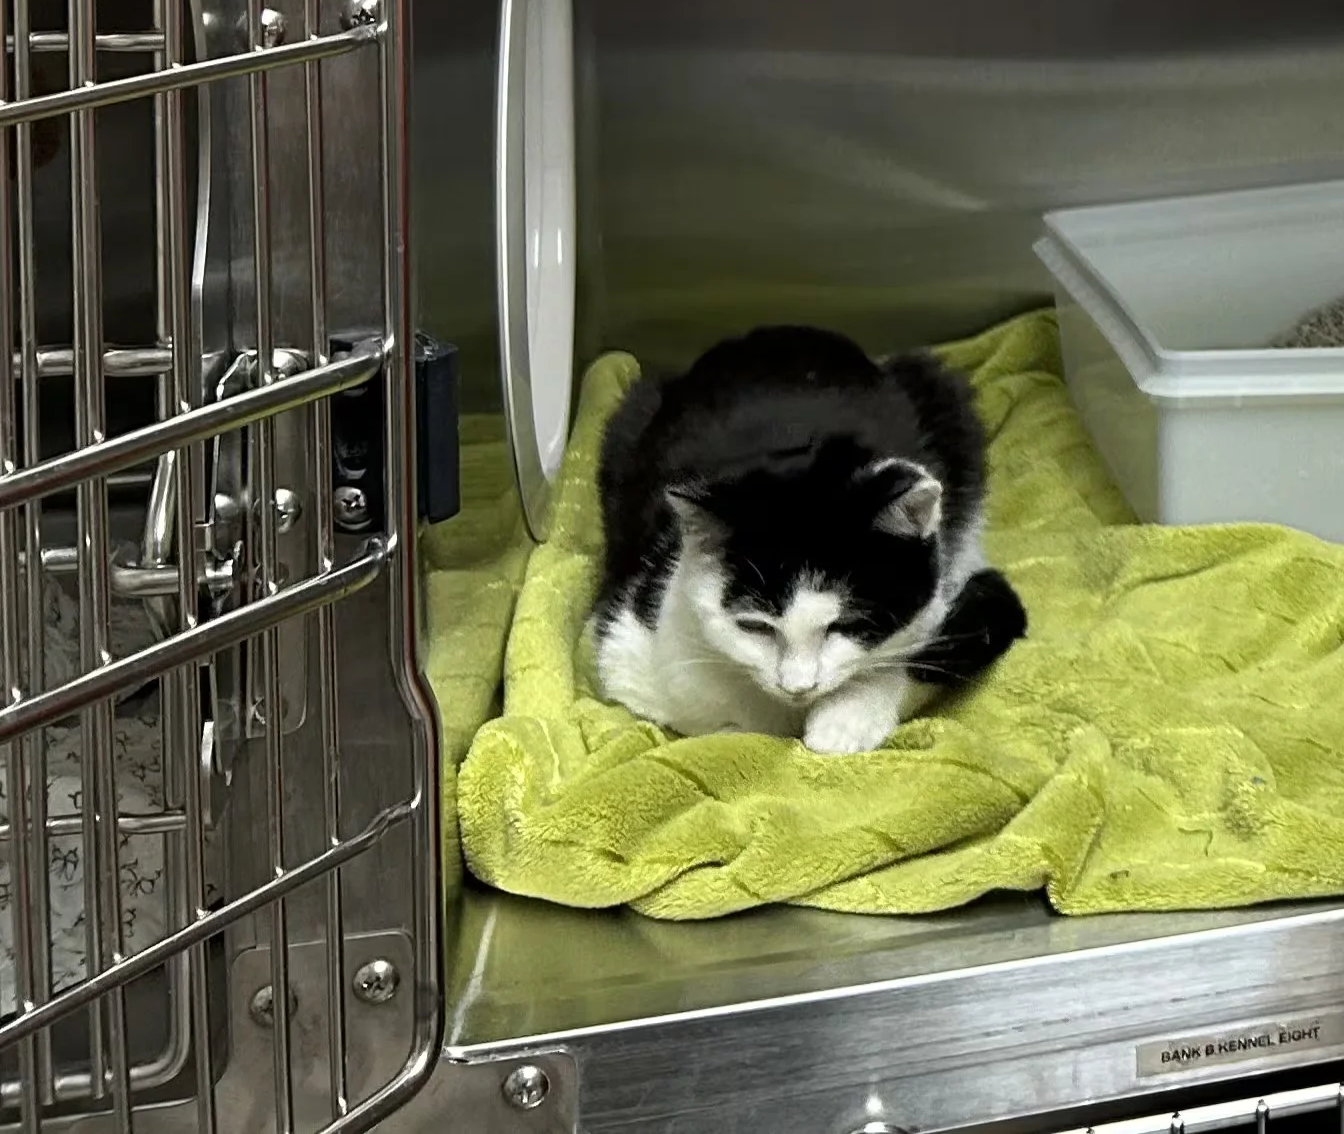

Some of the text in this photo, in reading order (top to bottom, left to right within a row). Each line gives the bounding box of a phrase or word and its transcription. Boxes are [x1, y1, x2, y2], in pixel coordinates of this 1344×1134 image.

[1161, 1026, 1320, 1063] BANK B KENNEL EIGHT
